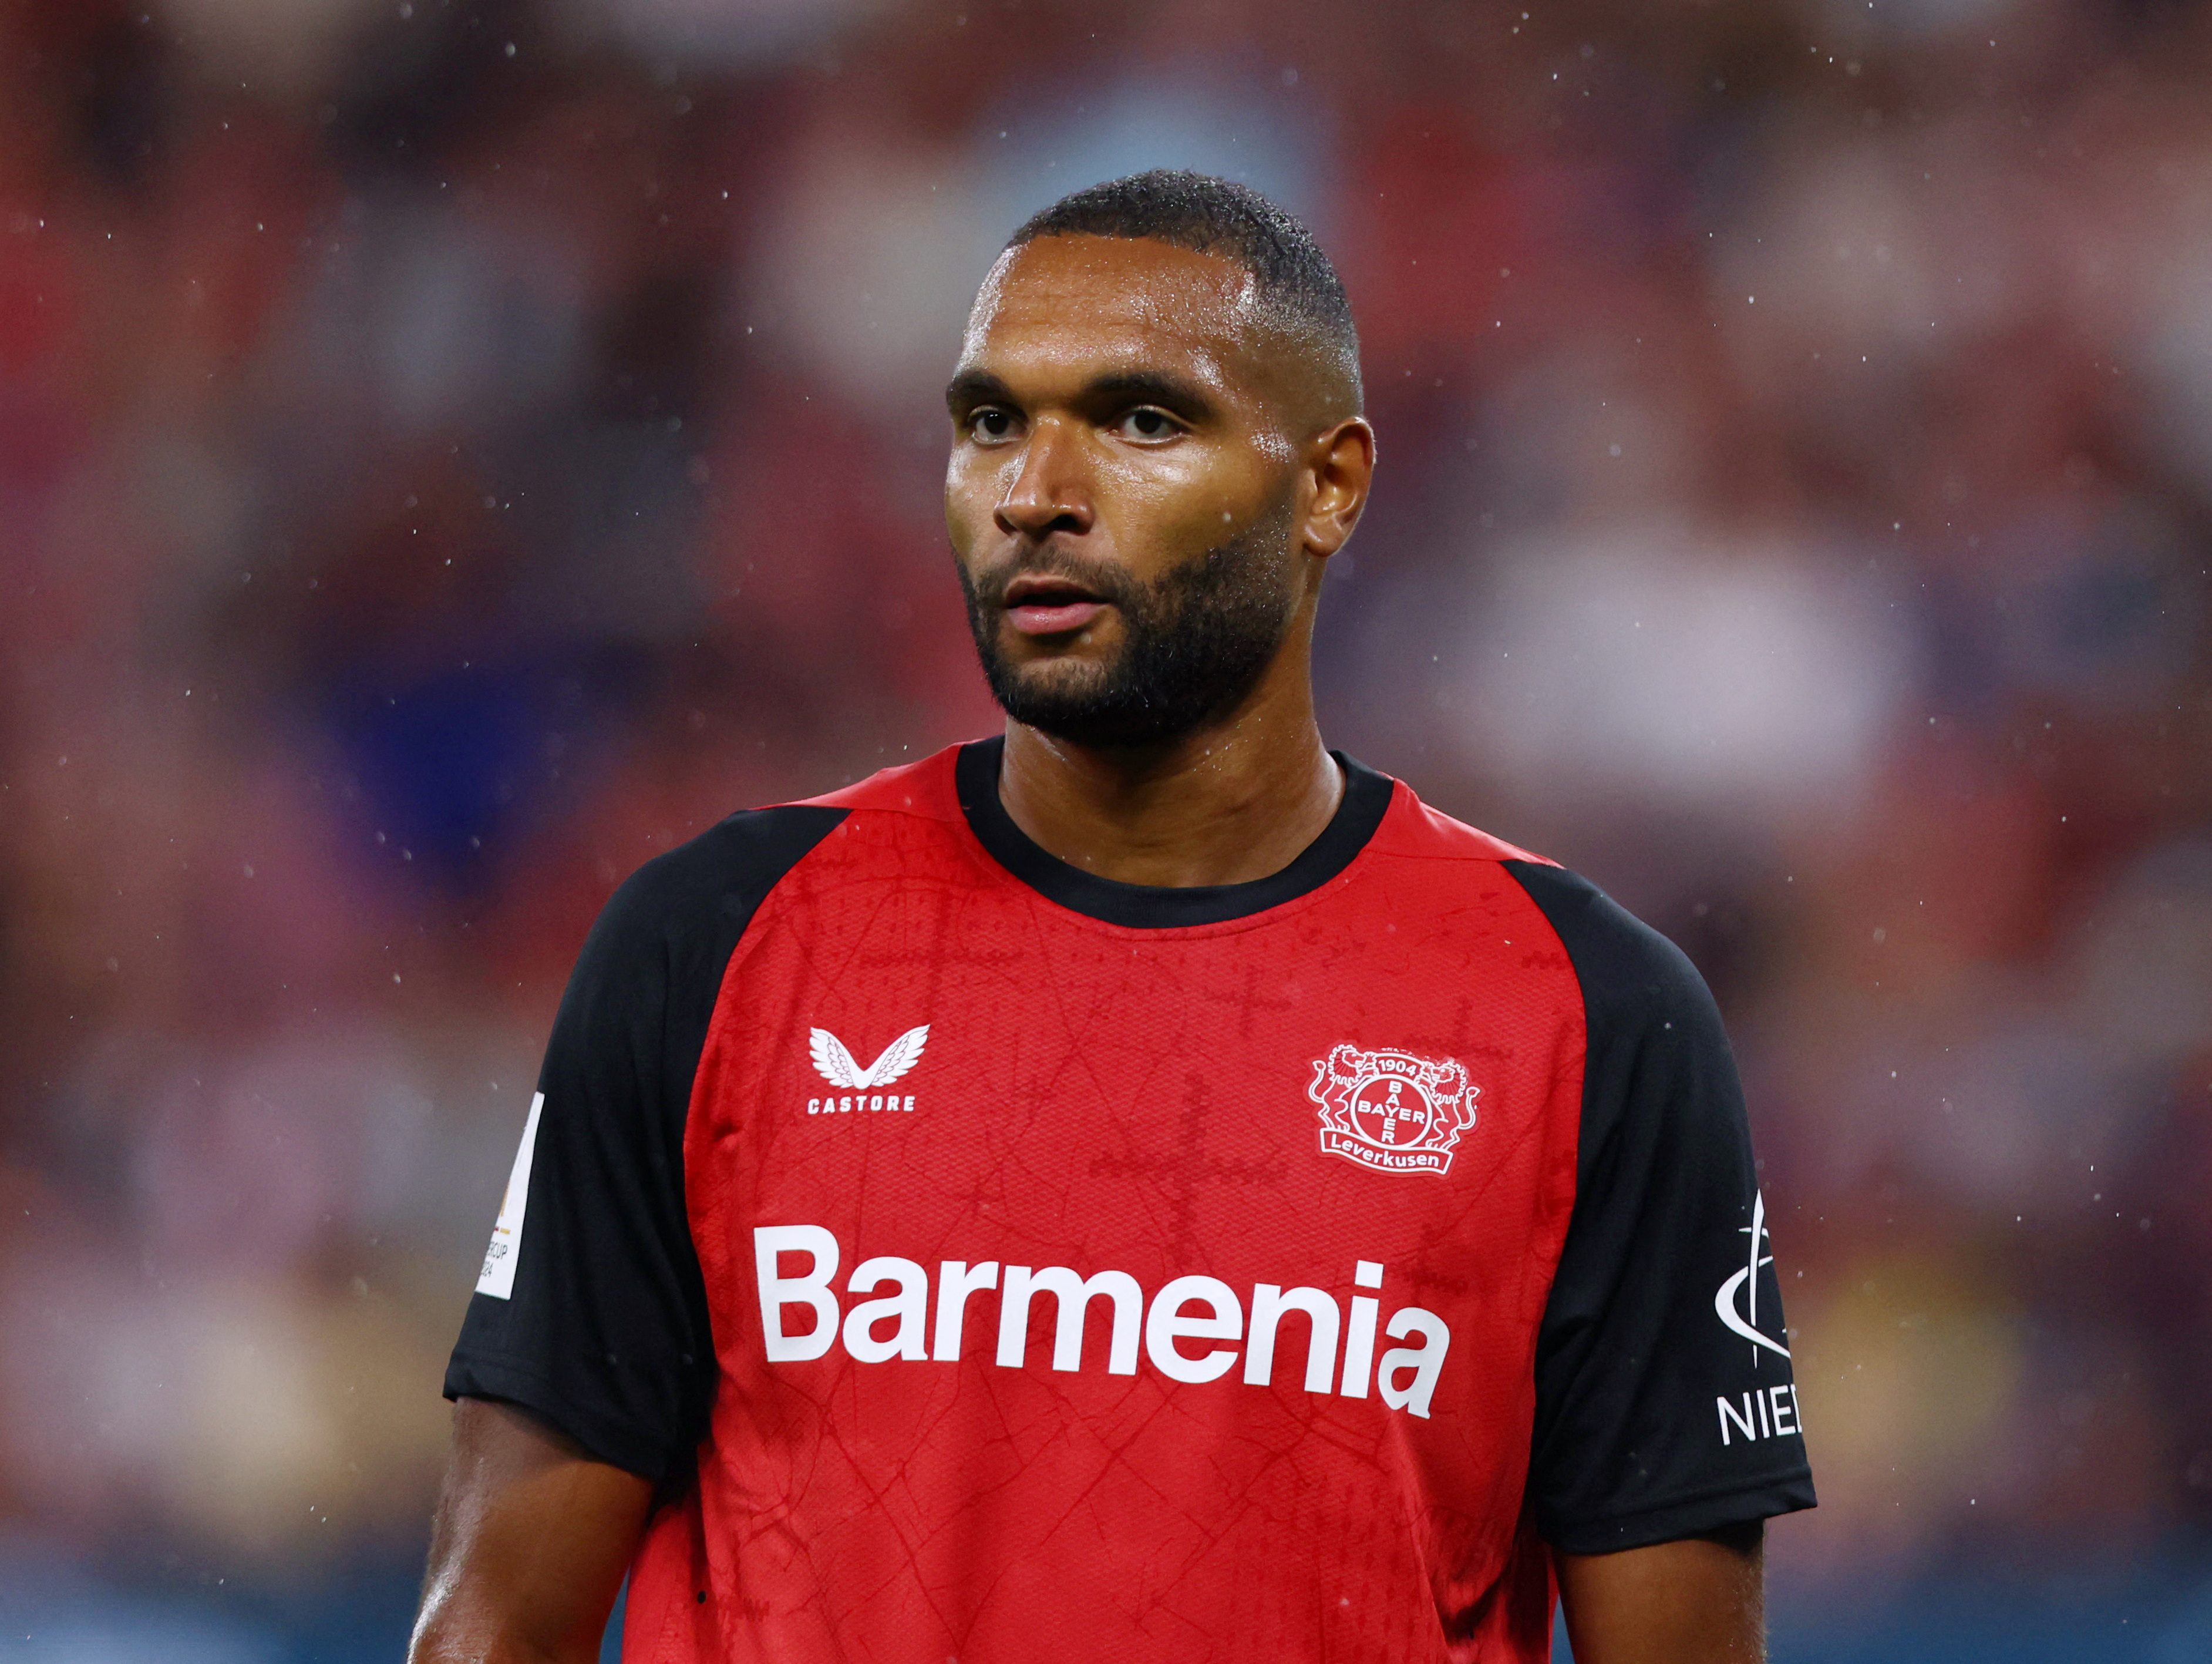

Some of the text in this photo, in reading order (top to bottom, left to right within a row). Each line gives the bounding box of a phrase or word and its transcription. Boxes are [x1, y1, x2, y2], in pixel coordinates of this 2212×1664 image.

[1378, 1059, 1417, 1077] 1904
[807, 1095, 915, 1115] CASTORE
[1357, 1100, 1426, 1125] BAYER
[1381, 1080, 1403, 1144] BAYER
[1331, 1133, 1439, 1168] Leverkusen
[754, 1225, 1449, 1418] Barmenia
[1717, 1384, 1803, 1446] NIE
